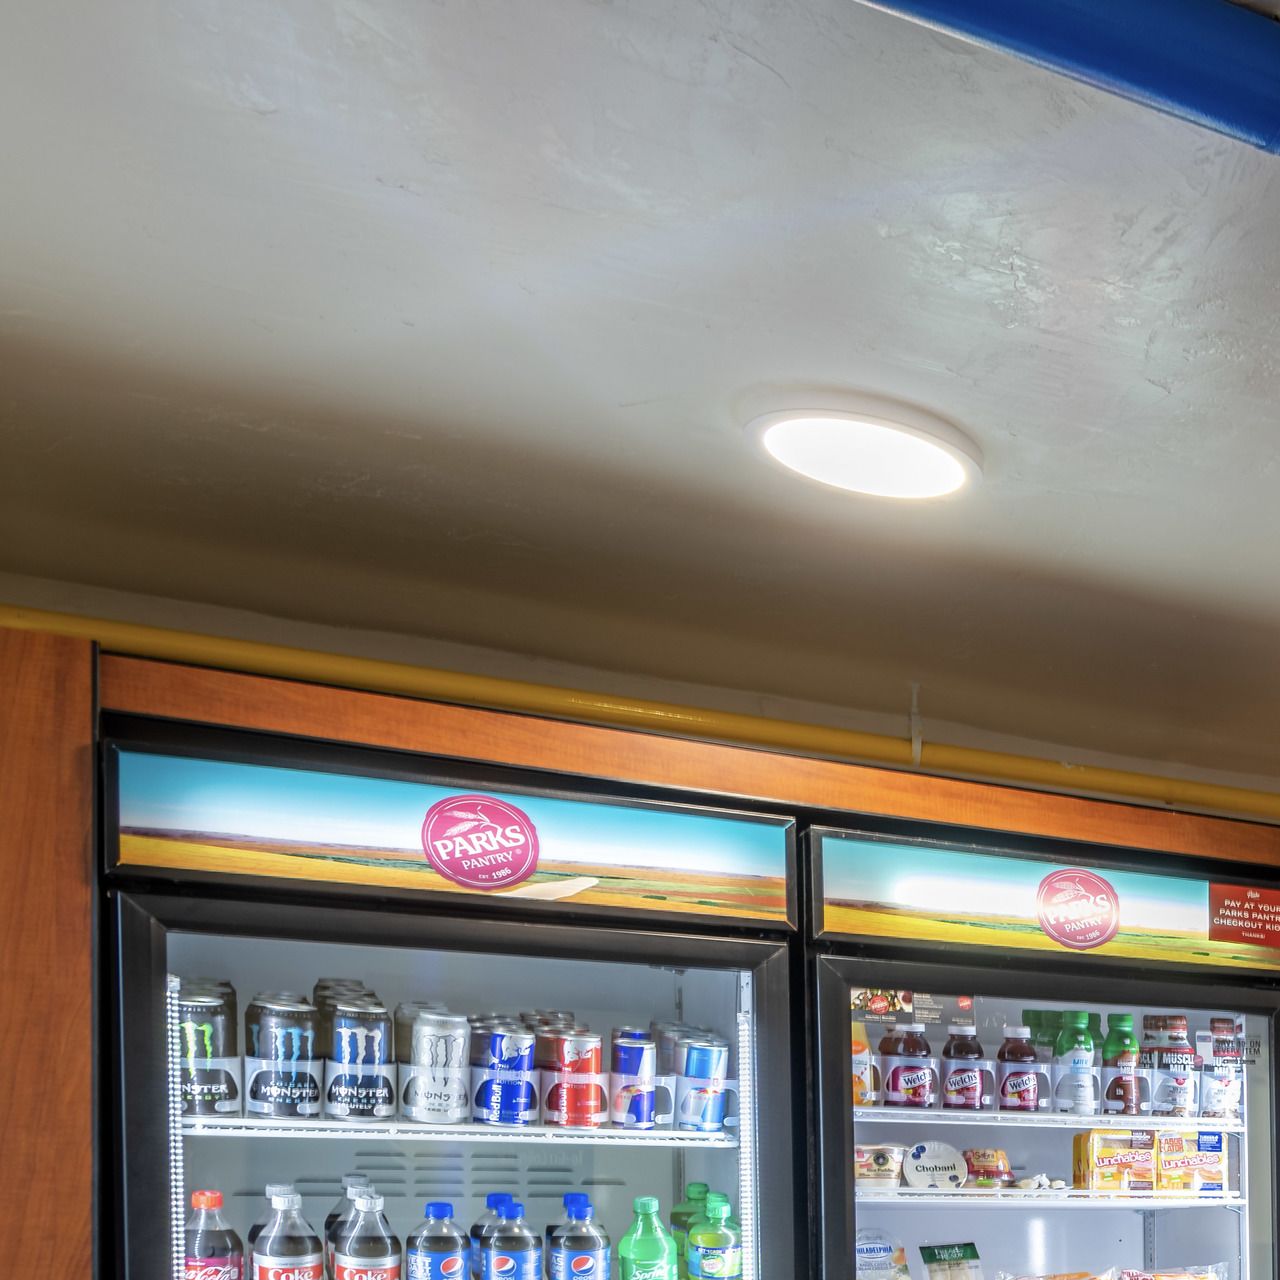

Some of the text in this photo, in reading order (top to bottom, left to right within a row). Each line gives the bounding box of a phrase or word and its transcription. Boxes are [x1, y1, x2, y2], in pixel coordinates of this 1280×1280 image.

[433, 825, 525, 860] PARKS
[461, 851, 513, 870] PANTRY
[492, 867, 511, 880] 1986
[1224, 898, 1241, 908] PAY
[1244, 900, 1255, 909] AT
[1219, 908, 1249, 919] PARKS
[1064, 916, 1102, 933] PANTRY
[1213, 917, 1263, 930] CHECKOUT
[949, 1071, 978, 1089] Welch's
[1096, 1151, 1152, 1167] Lunchables
[1162, 1154, 1220, 1169] Lunchables
[915, 1164, 956, 1173] Chobani
